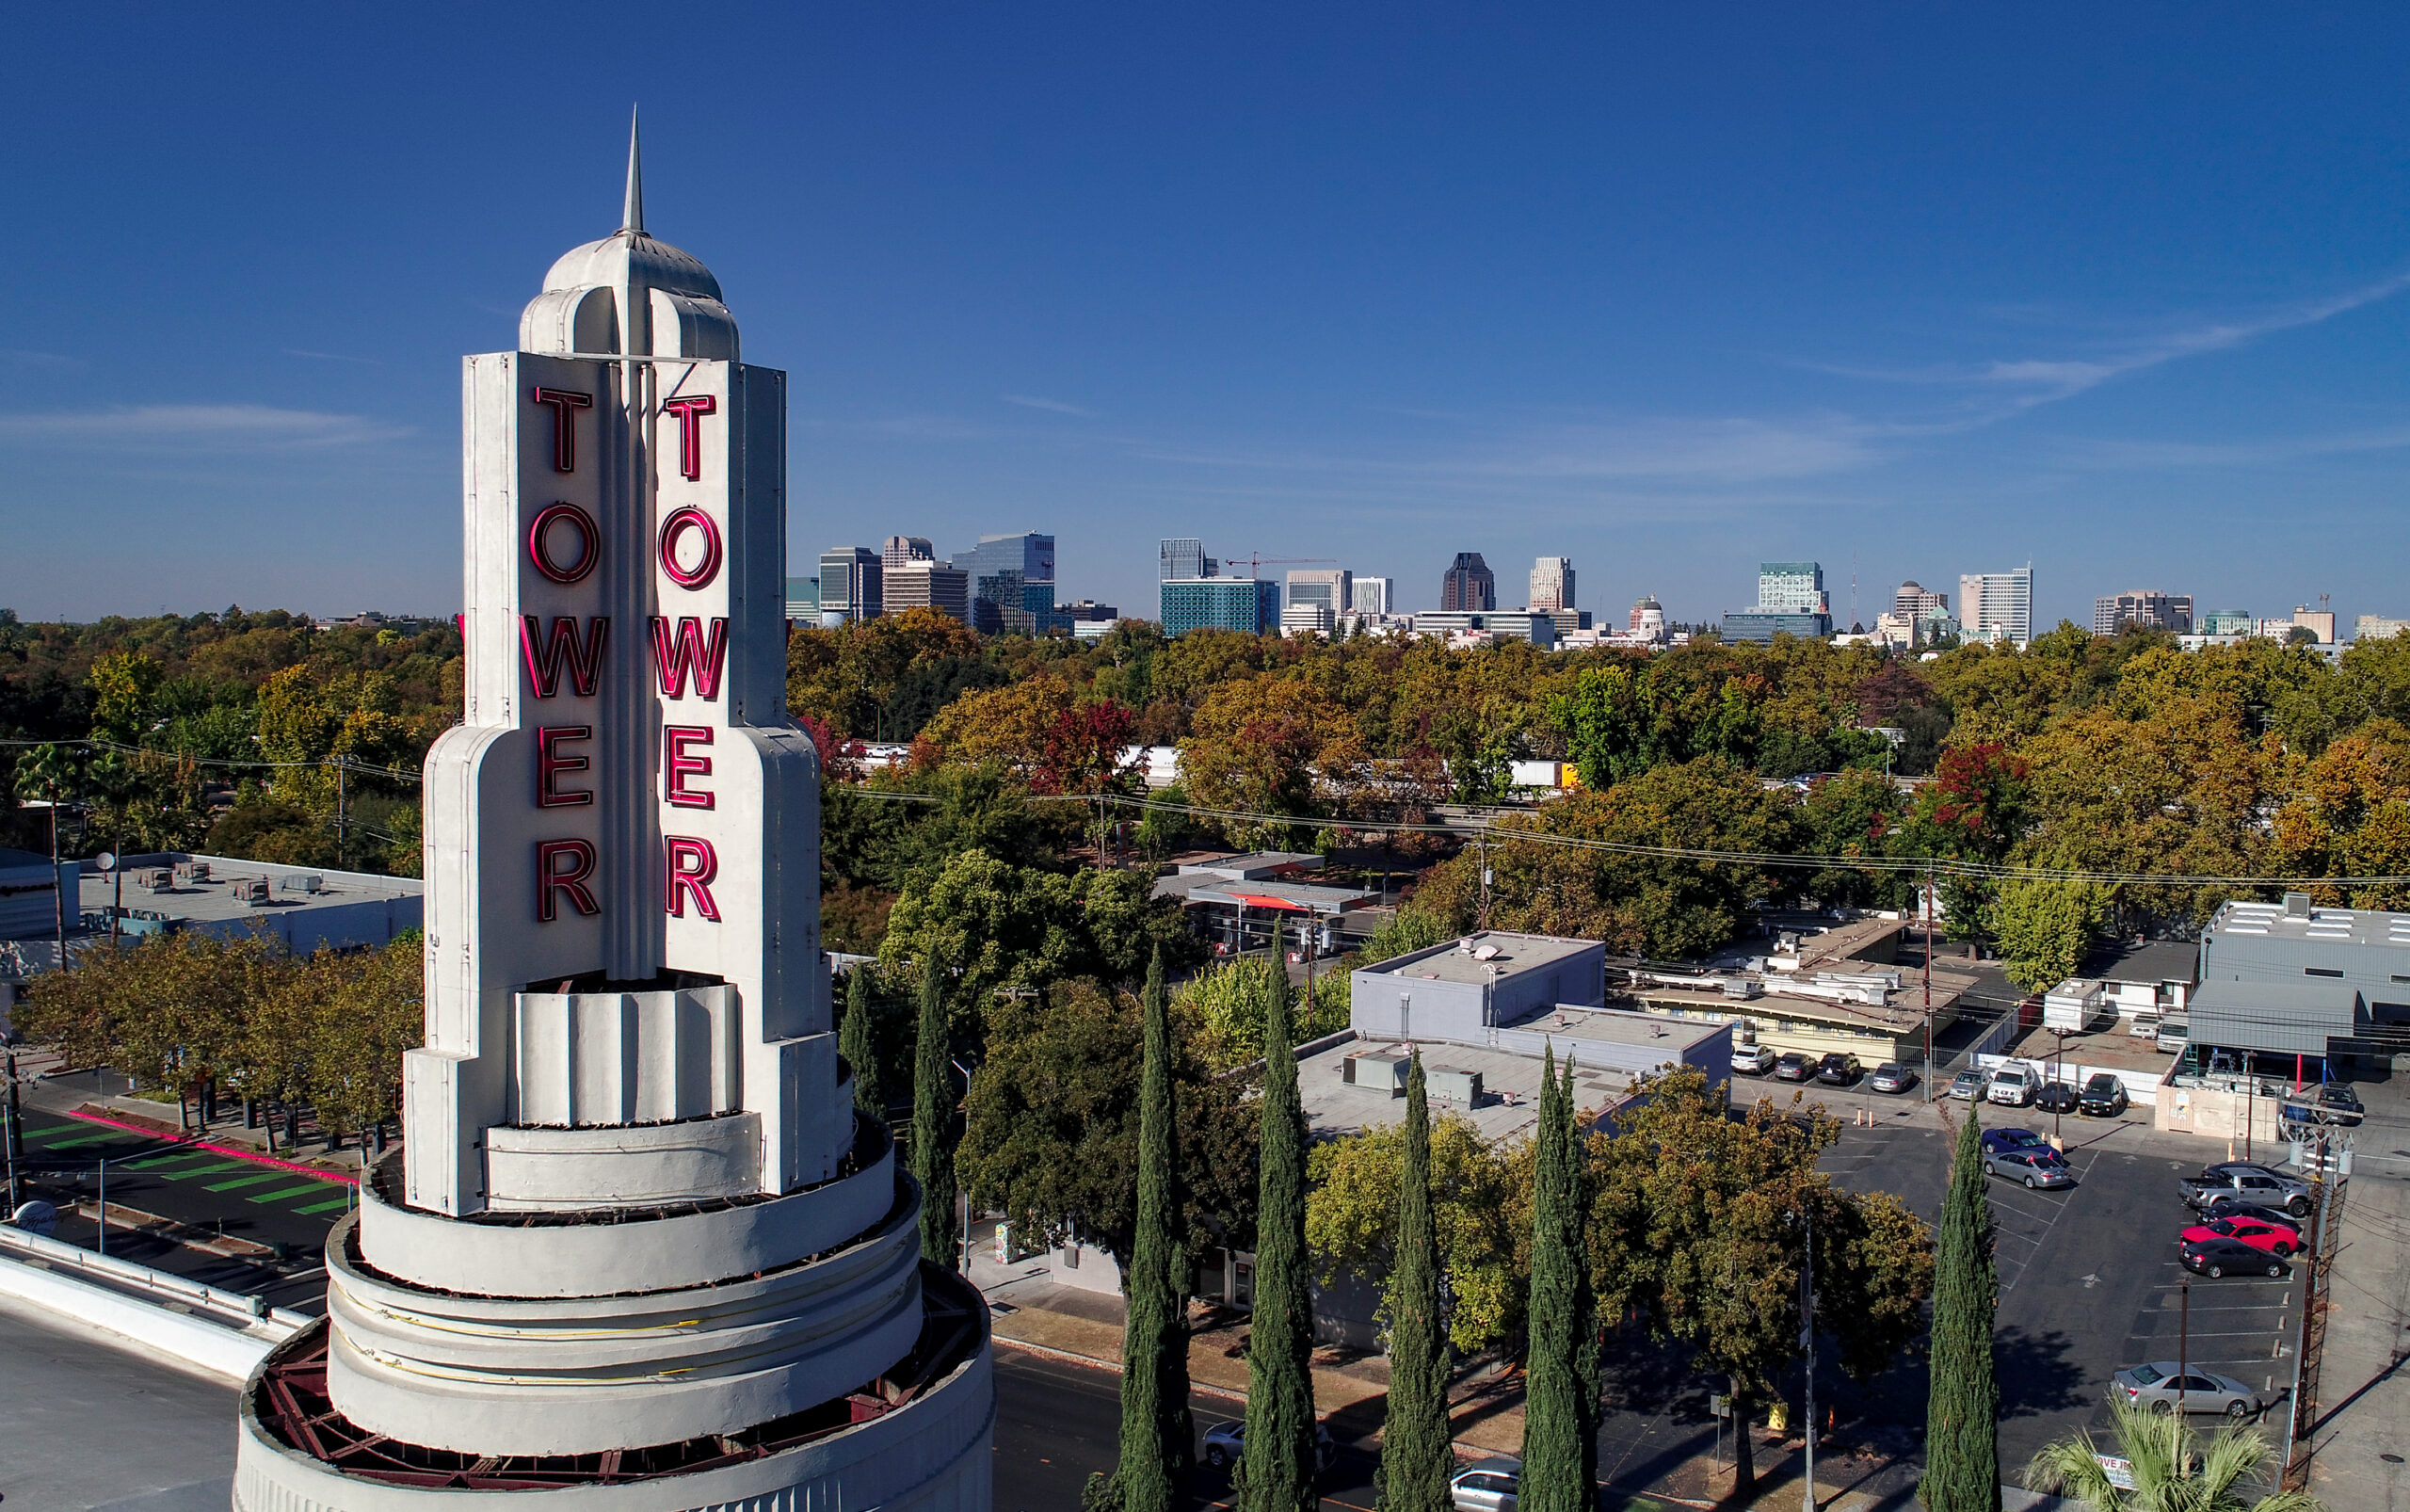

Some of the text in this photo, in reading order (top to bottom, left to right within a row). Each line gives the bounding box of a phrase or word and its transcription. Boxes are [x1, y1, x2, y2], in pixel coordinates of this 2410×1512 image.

[520, 386, 610, 923] TOWER
[650, 394, 730, 922] TOWER
[2096, 1456, 2116, 1469] OVE
